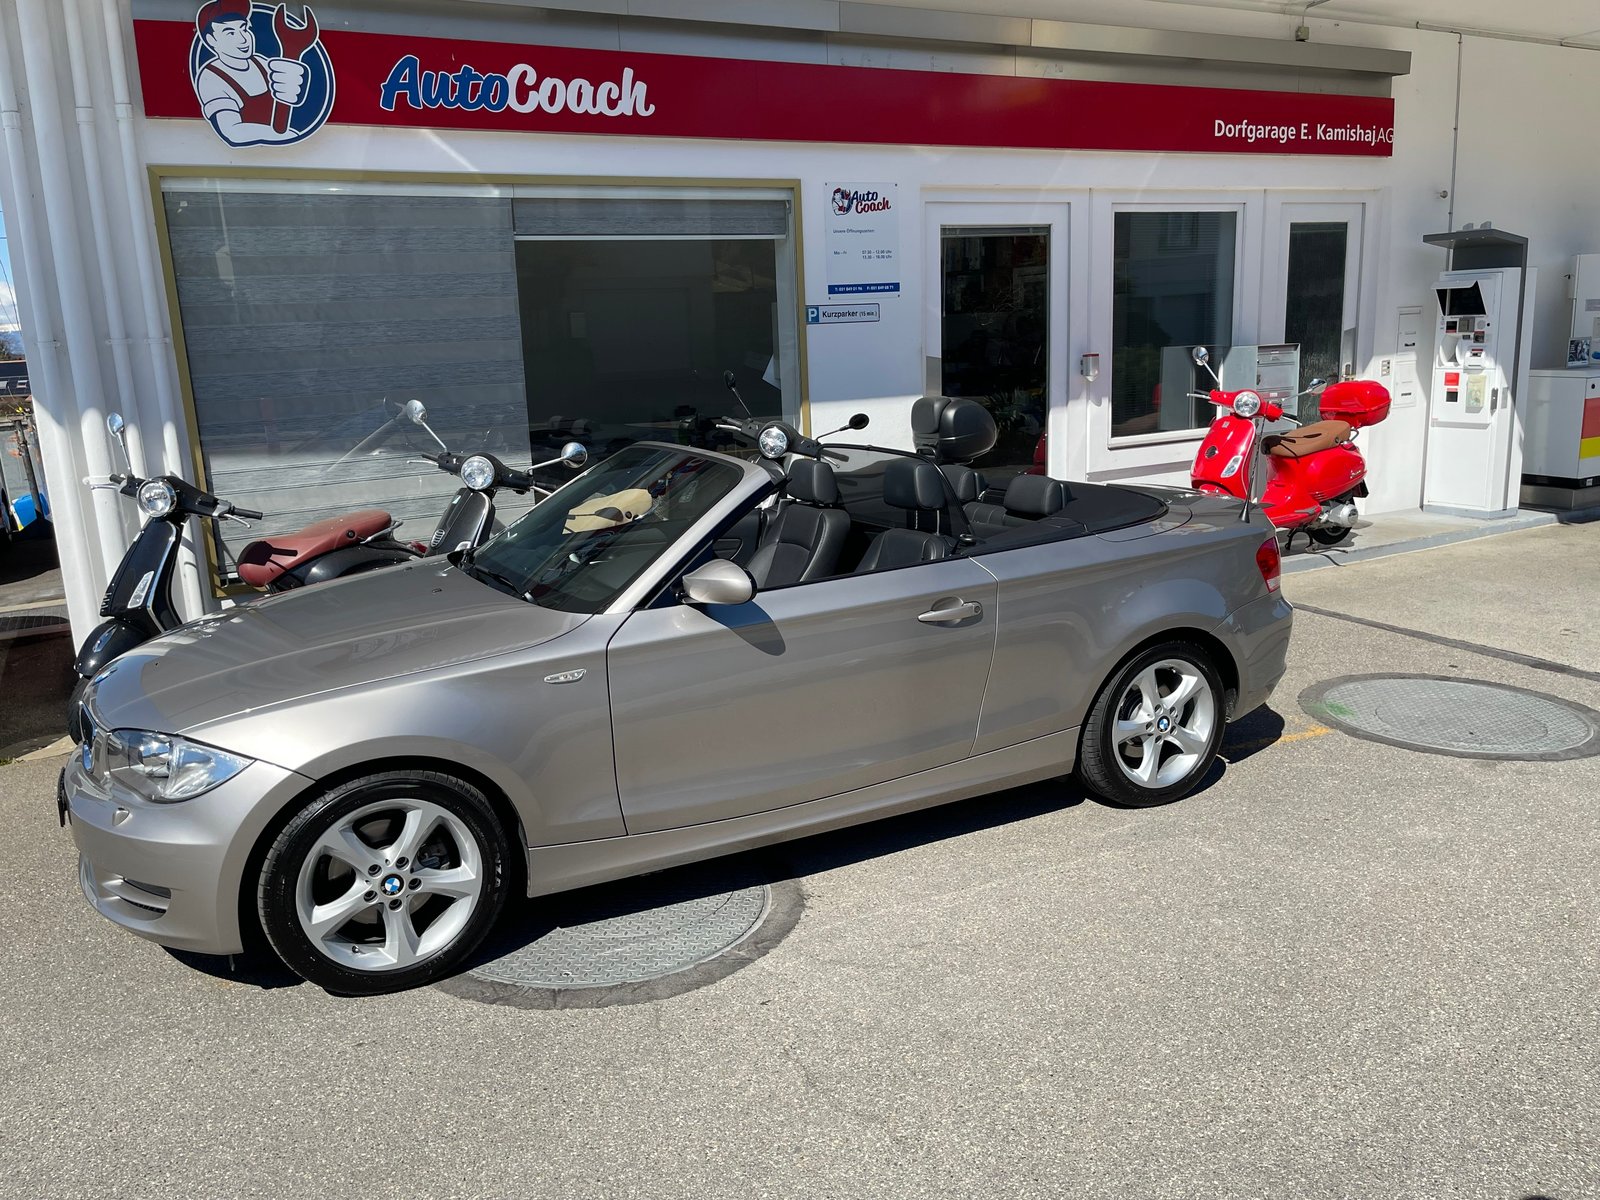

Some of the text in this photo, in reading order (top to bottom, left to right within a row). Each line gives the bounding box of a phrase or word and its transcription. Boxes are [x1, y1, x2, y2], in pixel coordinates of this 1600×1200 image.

[1214, 119, 1297, 144] Dorfgarage
[1300, 123, 1313, 140] E.
[851, 190, 879, 205] Auto
[855, 197, 892, 214] Coach
[822, 310, 858, 318] Kurzparker
